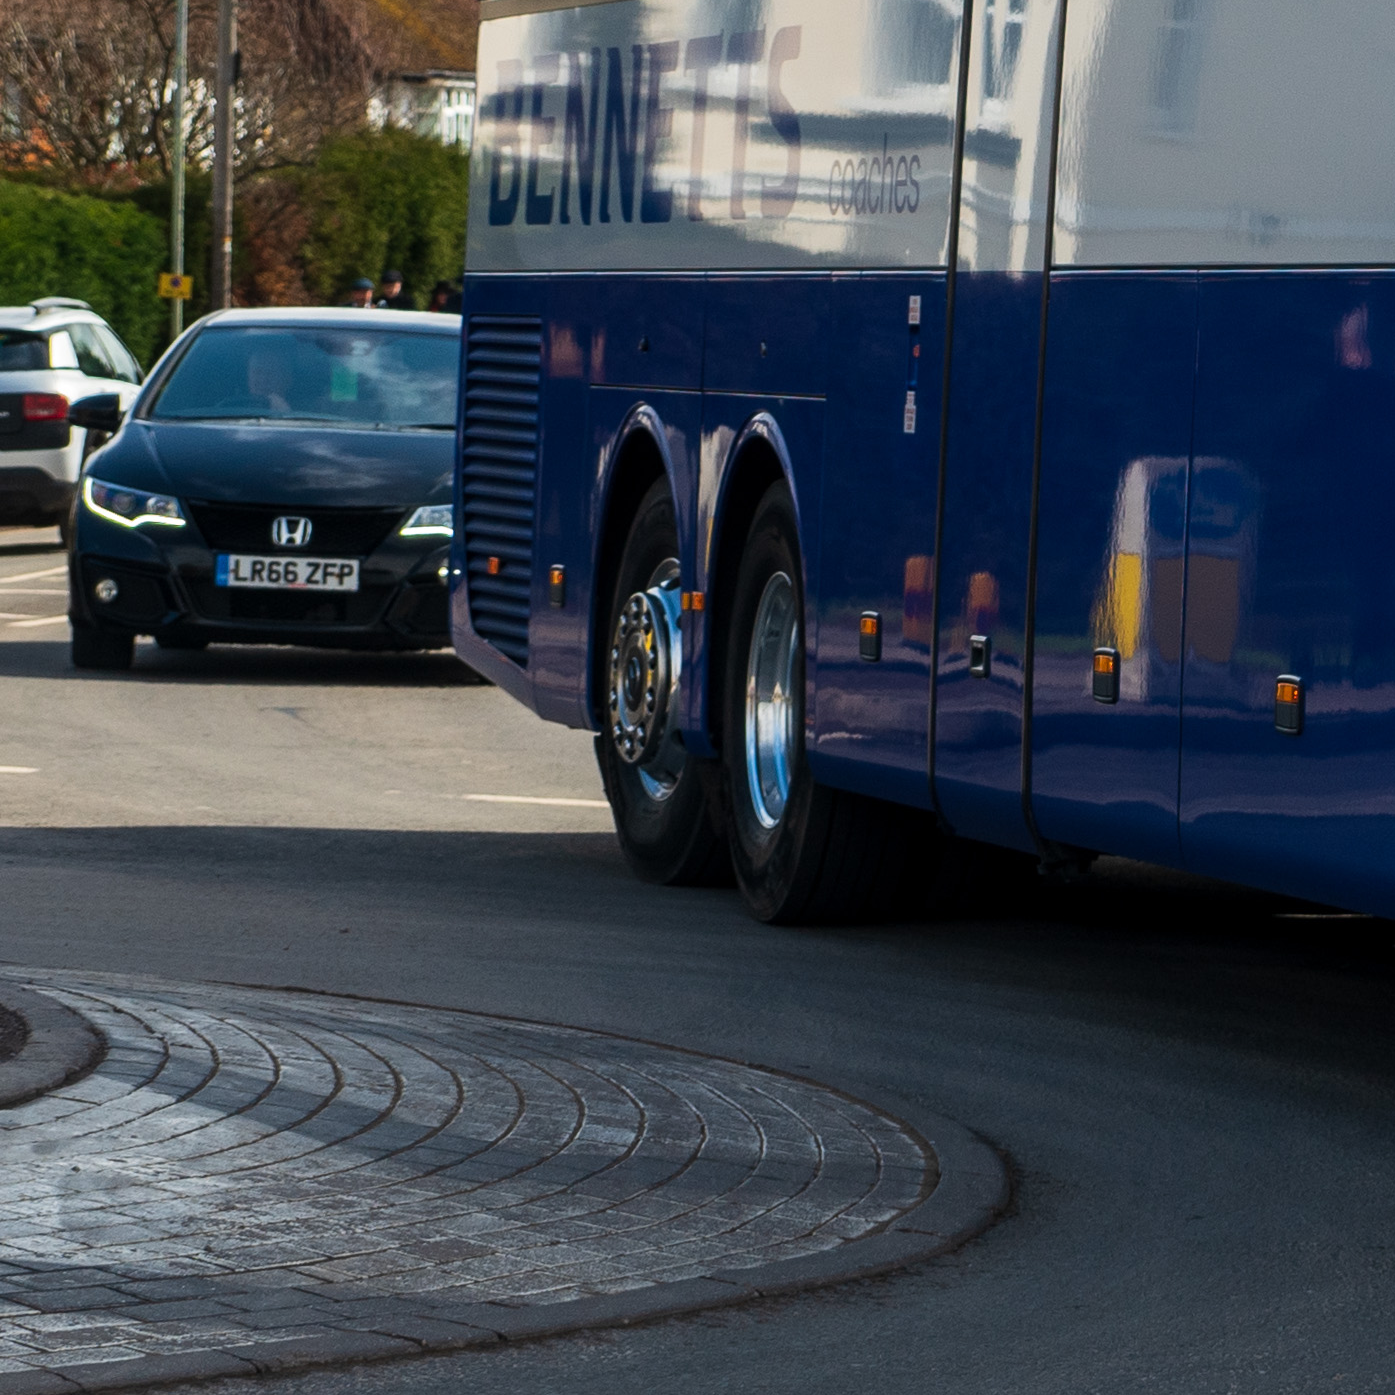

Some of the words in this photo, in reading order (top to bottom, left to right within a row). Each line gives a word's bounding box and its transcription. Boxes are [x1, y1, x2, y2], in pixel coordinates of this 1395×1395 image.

[488, 24, 802, 226] BENNETTS
[828, 133, 921, 216] coaches
[234, 559, 298, 583] LR66
[306, 562, 354, 586] ZFP
